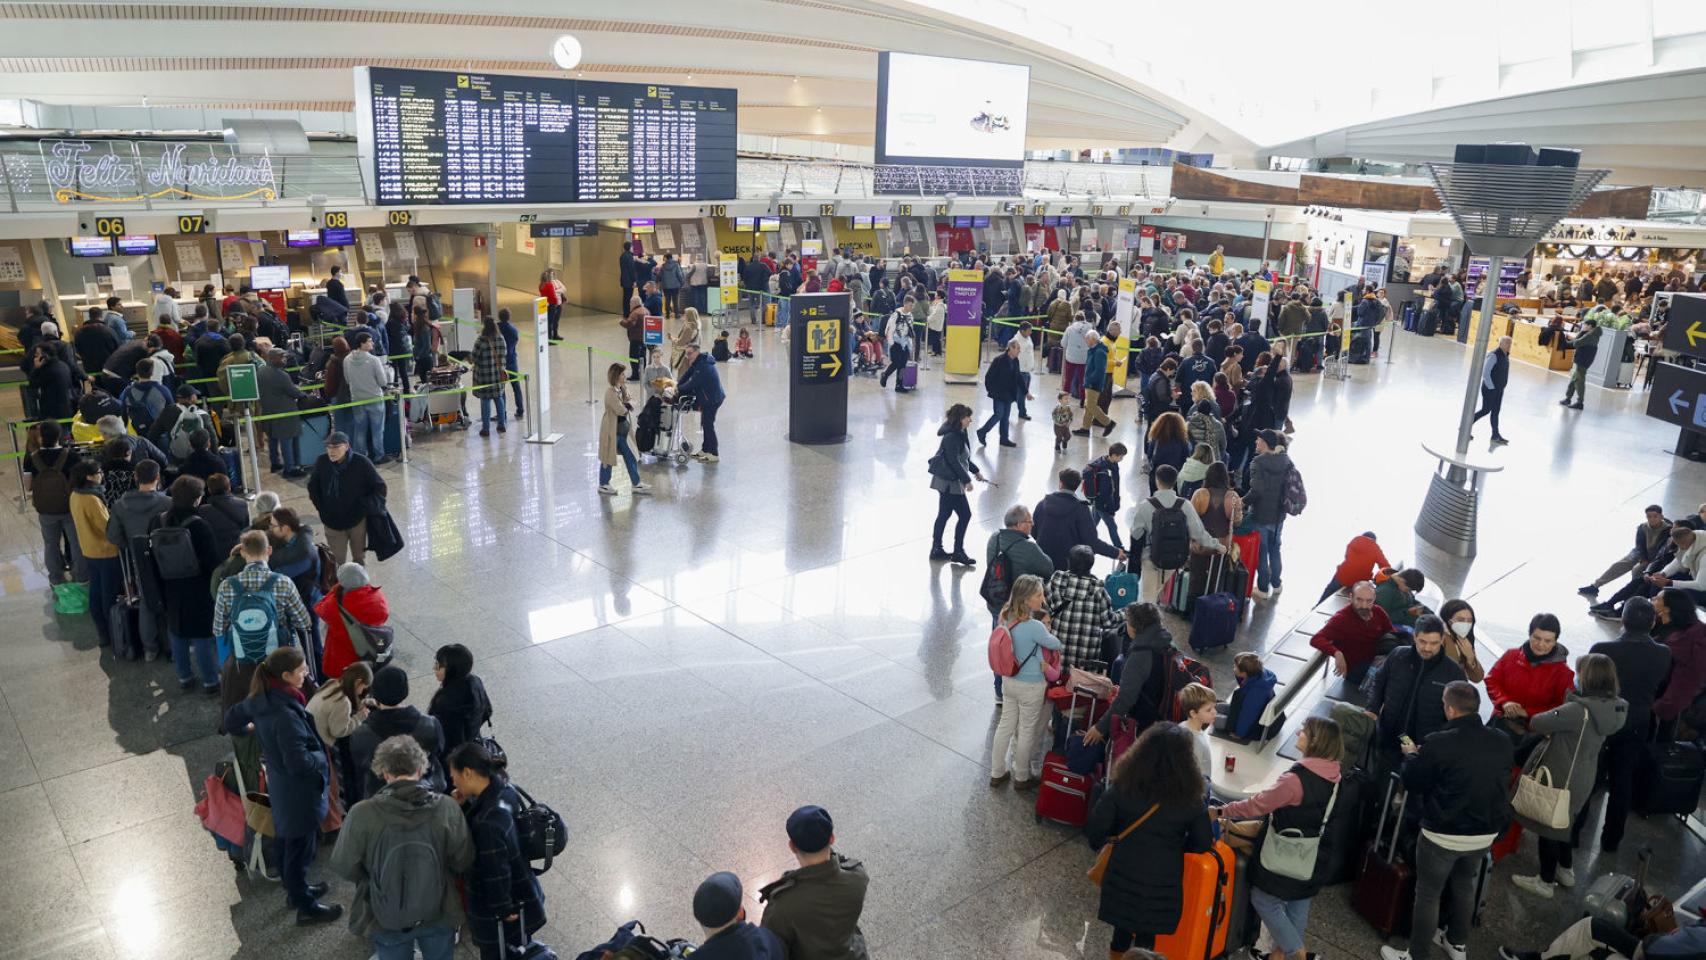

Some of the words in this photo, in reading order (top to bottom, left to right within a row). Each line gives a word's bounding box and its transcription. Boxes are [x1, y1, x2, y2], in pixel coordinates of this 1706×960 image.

[49, 142, 136, 188] Feliz
[148, 144, 275, 187] Navidad
[711, 205, 726, 217] 10
[779, 204, 793, 216] 11
[820, 205, 834, 216] 12
[900, 205, 911, 216] 13
[935, 205, 946, 216] 14
[1016, 205, 1025, 216] 15
[1034, 205, 1044, 216] 16
[1093, 206, 1102, 216] 17
[1120, 206, 1129, 215] 18
[326, 213, 346, 228] 08
[389, 211, 409, 225] 09
[97, 219, 124, 236] 06
[179, 216, 203, 233] 07
